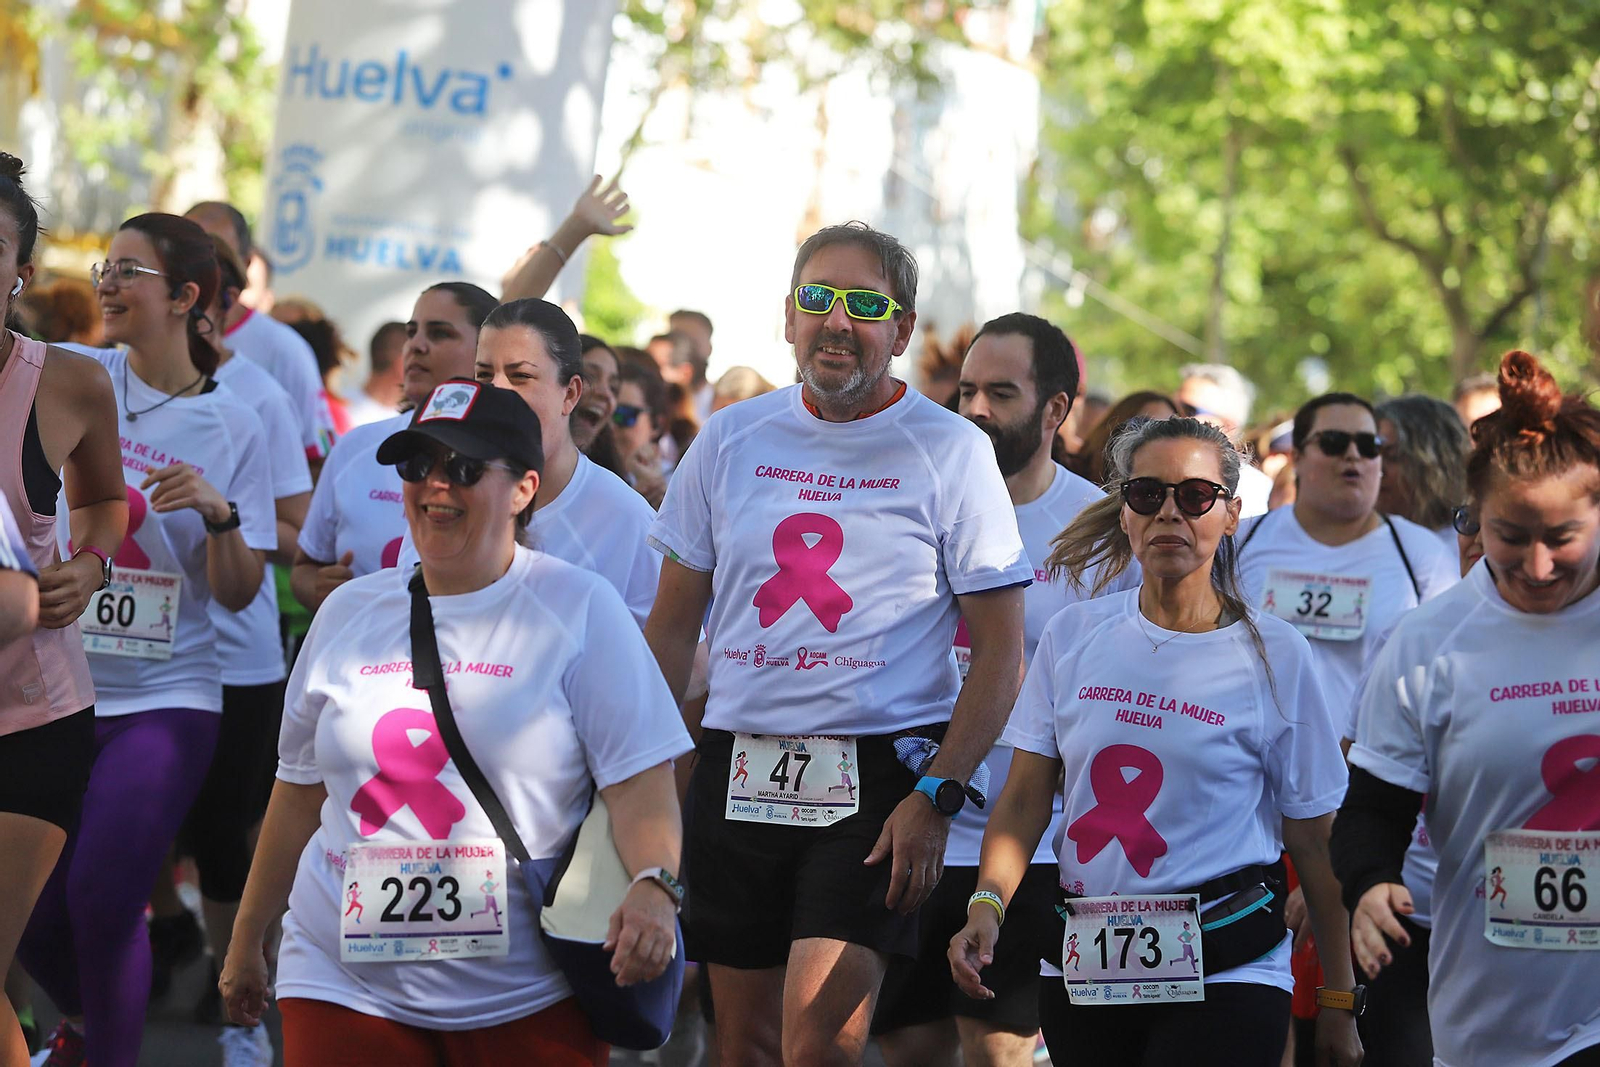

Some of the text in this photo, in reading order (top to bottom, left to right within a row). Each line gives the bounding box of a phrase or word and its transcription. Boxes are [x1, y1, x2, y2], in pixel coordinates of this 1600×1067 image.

[287, 47, 490, 116] Huelva
[325, 234, 463, 274] HUELVA
[134, 443, 150, 457] DE
[151, 449, 166, 463] LA
[122, 456, 149, 473] UELV
[755, 465, 900, 489] CARRERA DE LA MUJER
[798, 489, 842, 501] HUELVA
[97, 593, 135, 627] 60
[1297, 591, 1332, 617] 32
[724, 647, 748, 660] Huelva
[360, 661, 413, 676] CARRER
[446, 661, 513, 678] LA MUJER
[1490, 681, 1563, 702] CARRERA
[1568, 679, 1589, 693] DE
[1078, 686, 1225, 726] CARRERA DE LA MUJER
[1115, 709, 1162, 729] HUELVA
[779, 740, 807, 752] HUELVA
[769, 751, 812, 792] 47
[733, 804, 760, 813] Huelva
[417, 847, 432, 859] DE
[436, 847, 451, 859] LA
[455, 846, 494, 858] MUJER
[1555, 838, 1571, 851] DE
[1575, 839, 1590, 851] LA
[400, 862, 442, 874] HUELVA
[1534, 866, 1587, 913] 66
[380, 876, 462, 922] 223
[1121, 901, 1135, 912] DE
[1138, 901, 1152, 911] LA
[1107, 915, 1143, 926] HUELVA
[348, 942, 384, 953] Huelva
[1094, 926, 1162, 970] 173
[1071, 987, 1097, 998] Huelva
